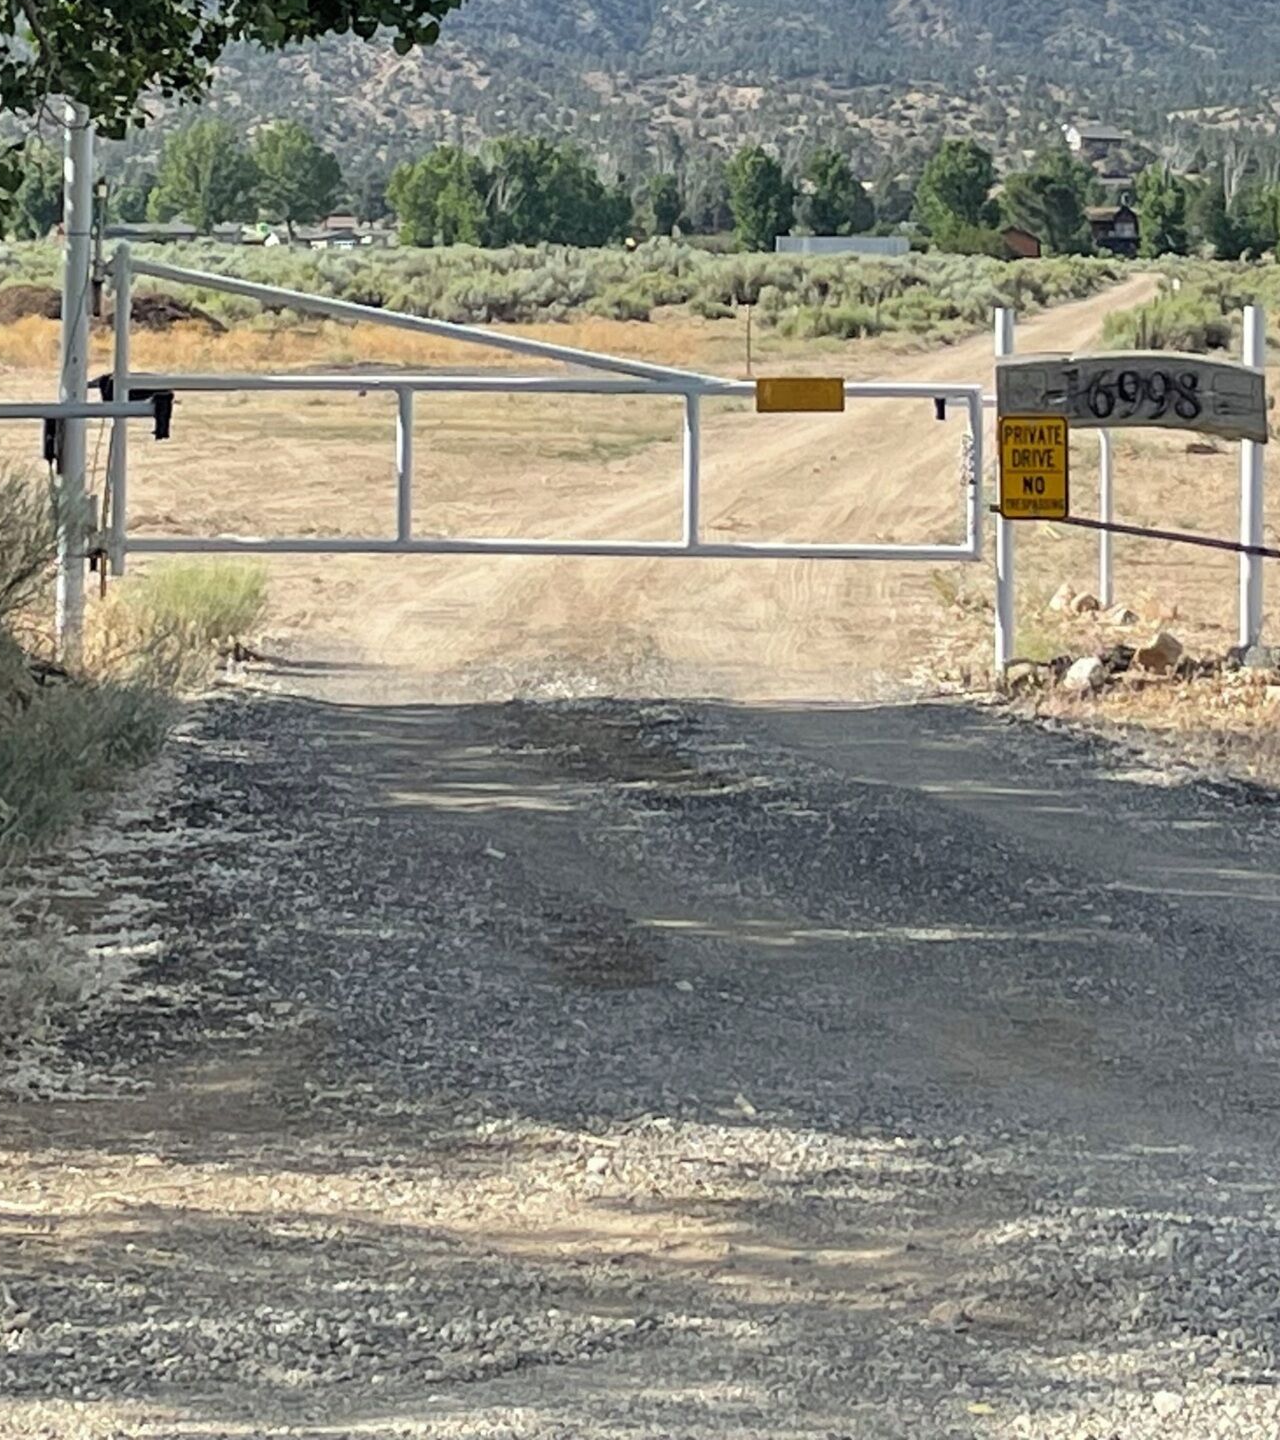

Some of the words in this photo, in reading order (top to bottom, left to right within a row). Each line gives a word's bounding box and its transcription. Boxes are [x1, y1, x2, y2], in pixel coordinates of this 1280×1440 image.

[1004, 425, 1064, 446] PRIVATE
[1011, 449, 1055, 468] DRIVE
[1022, 476, 1046, 496] NO
